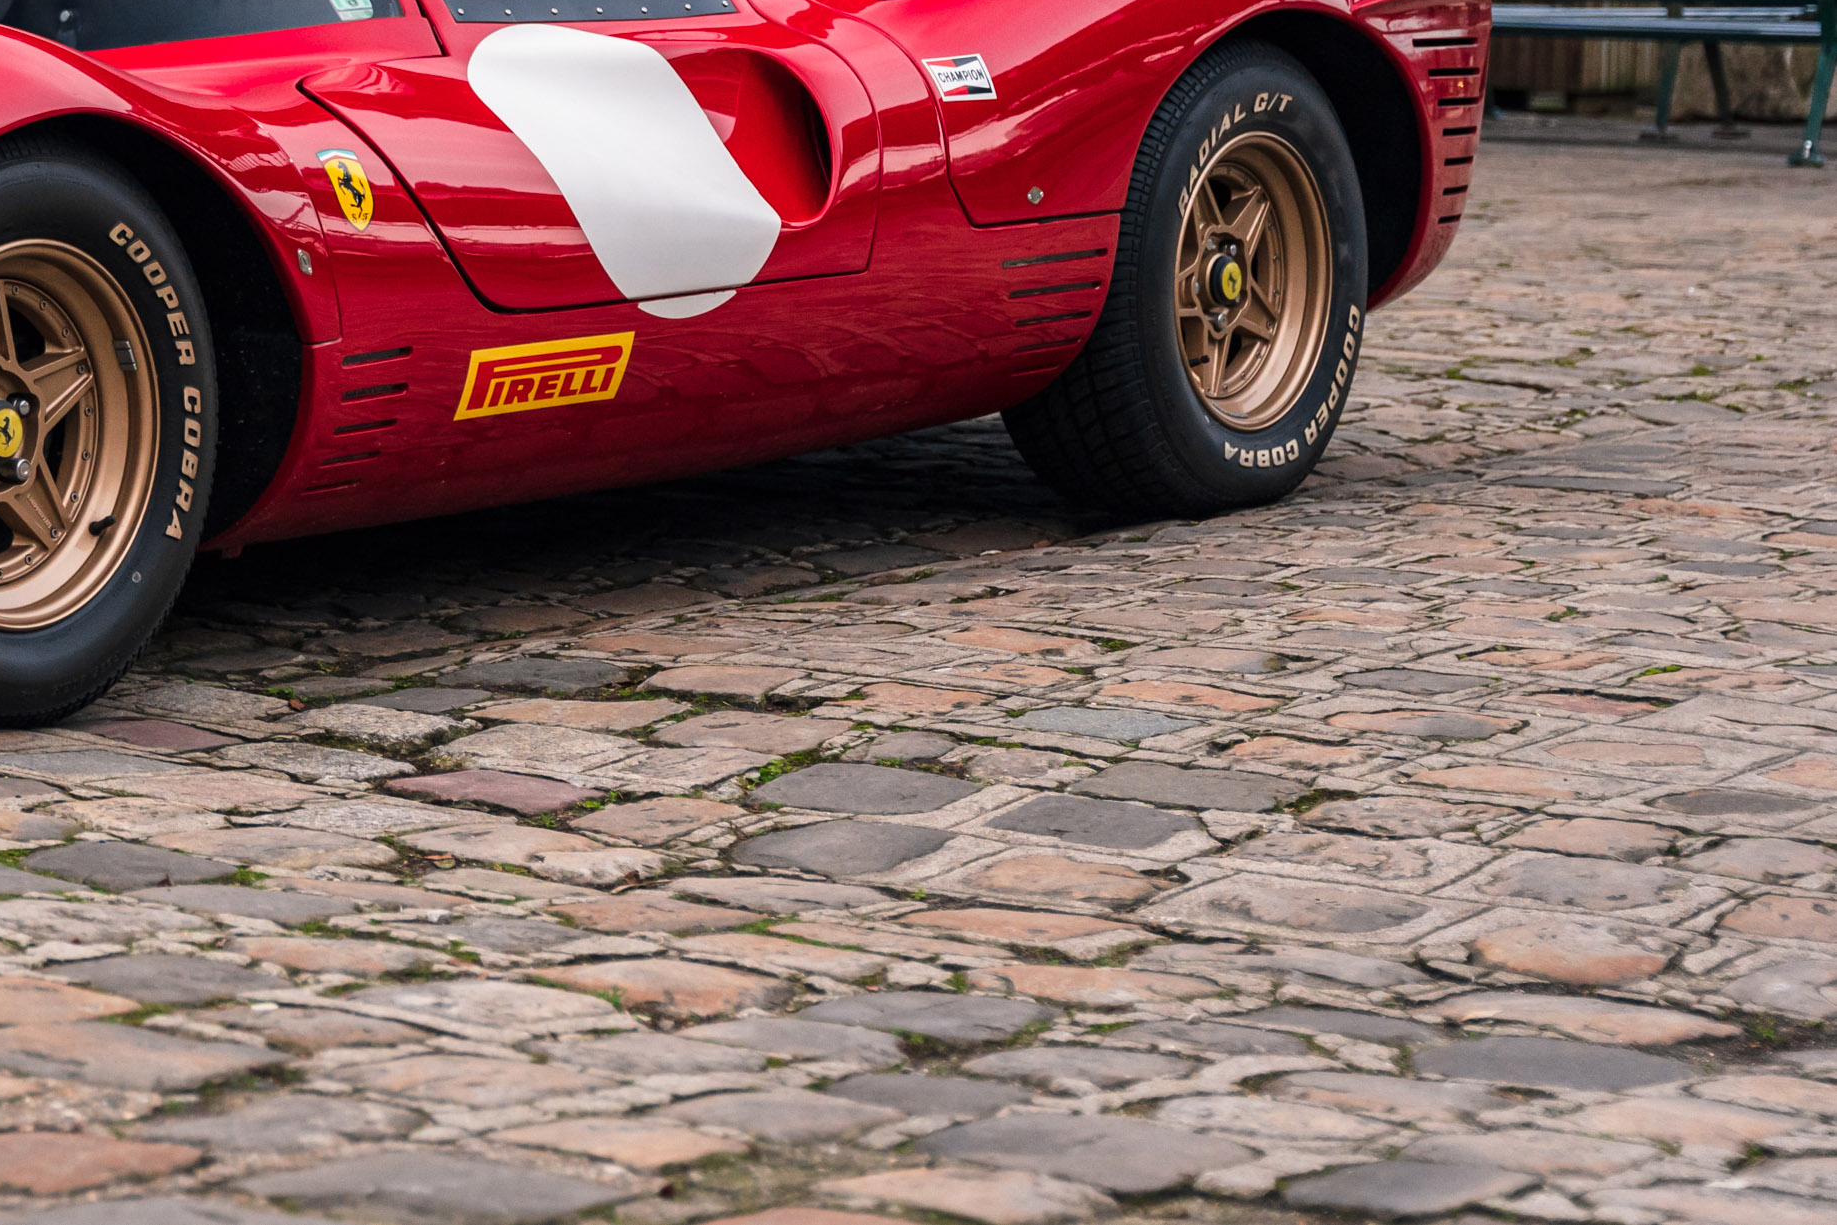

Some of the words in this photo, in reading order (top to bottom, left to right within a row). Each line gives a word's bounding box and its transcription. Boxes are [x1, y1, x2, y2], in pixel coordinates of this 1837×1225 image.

[938, 69, 984, 82] CHAMPION
[1177, 103, 1247, 218] RADIAL
[1253, 90, 1294, 114] G/T
[108, 221, 197, 369] COOPER
[164, 384, 203, 542] COBRA
[465, 344, 624, 411] PIRELLI
[1303, 303, 1361, 446] COOPER
[1223, 436, 1300, 469] COBRA
